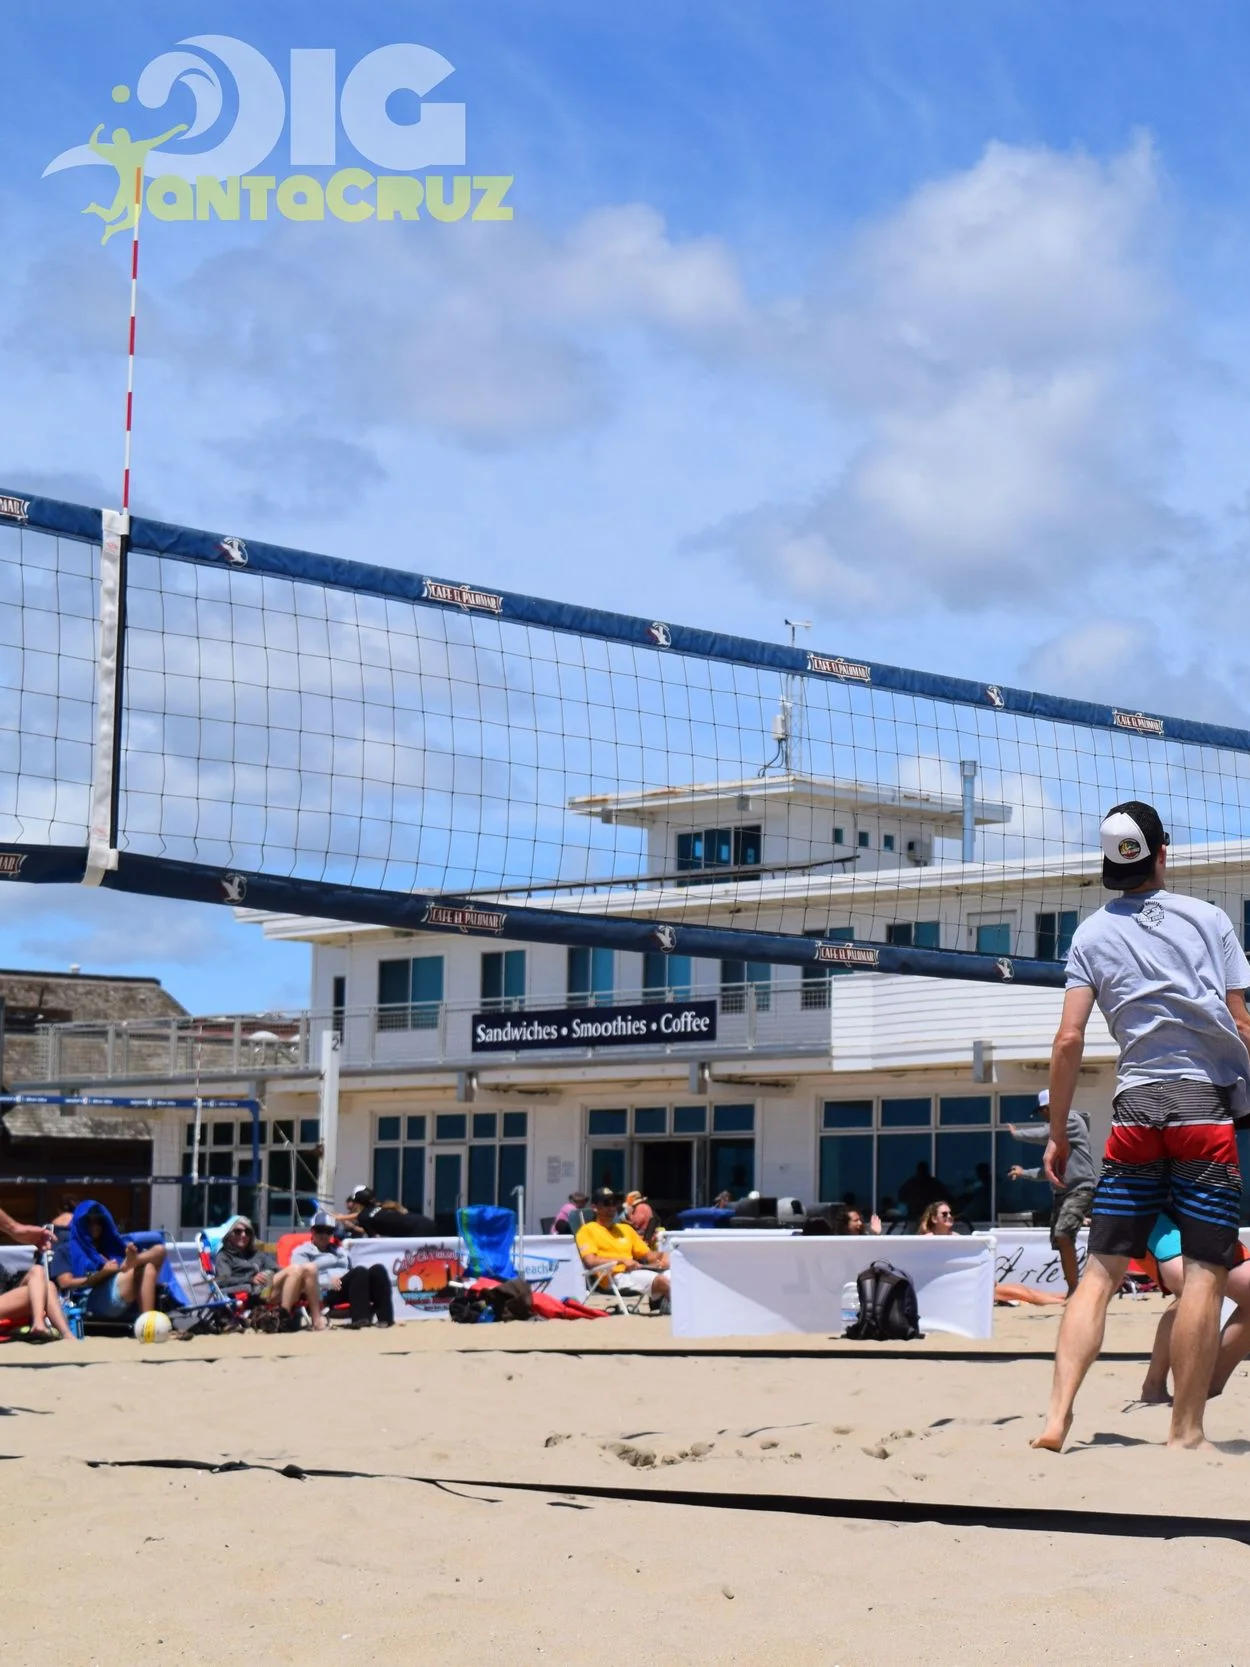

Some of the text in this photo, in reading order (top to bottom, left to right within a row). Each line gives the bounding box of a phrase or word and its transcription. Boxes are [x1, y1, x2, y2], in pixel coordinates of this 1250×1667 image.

[465, 912, 499, 928] PALOMAR
[476, 1011, 710, 1043] Sandwiches Smoothies Coffee
[332, 1036, 340, 1051] 2
